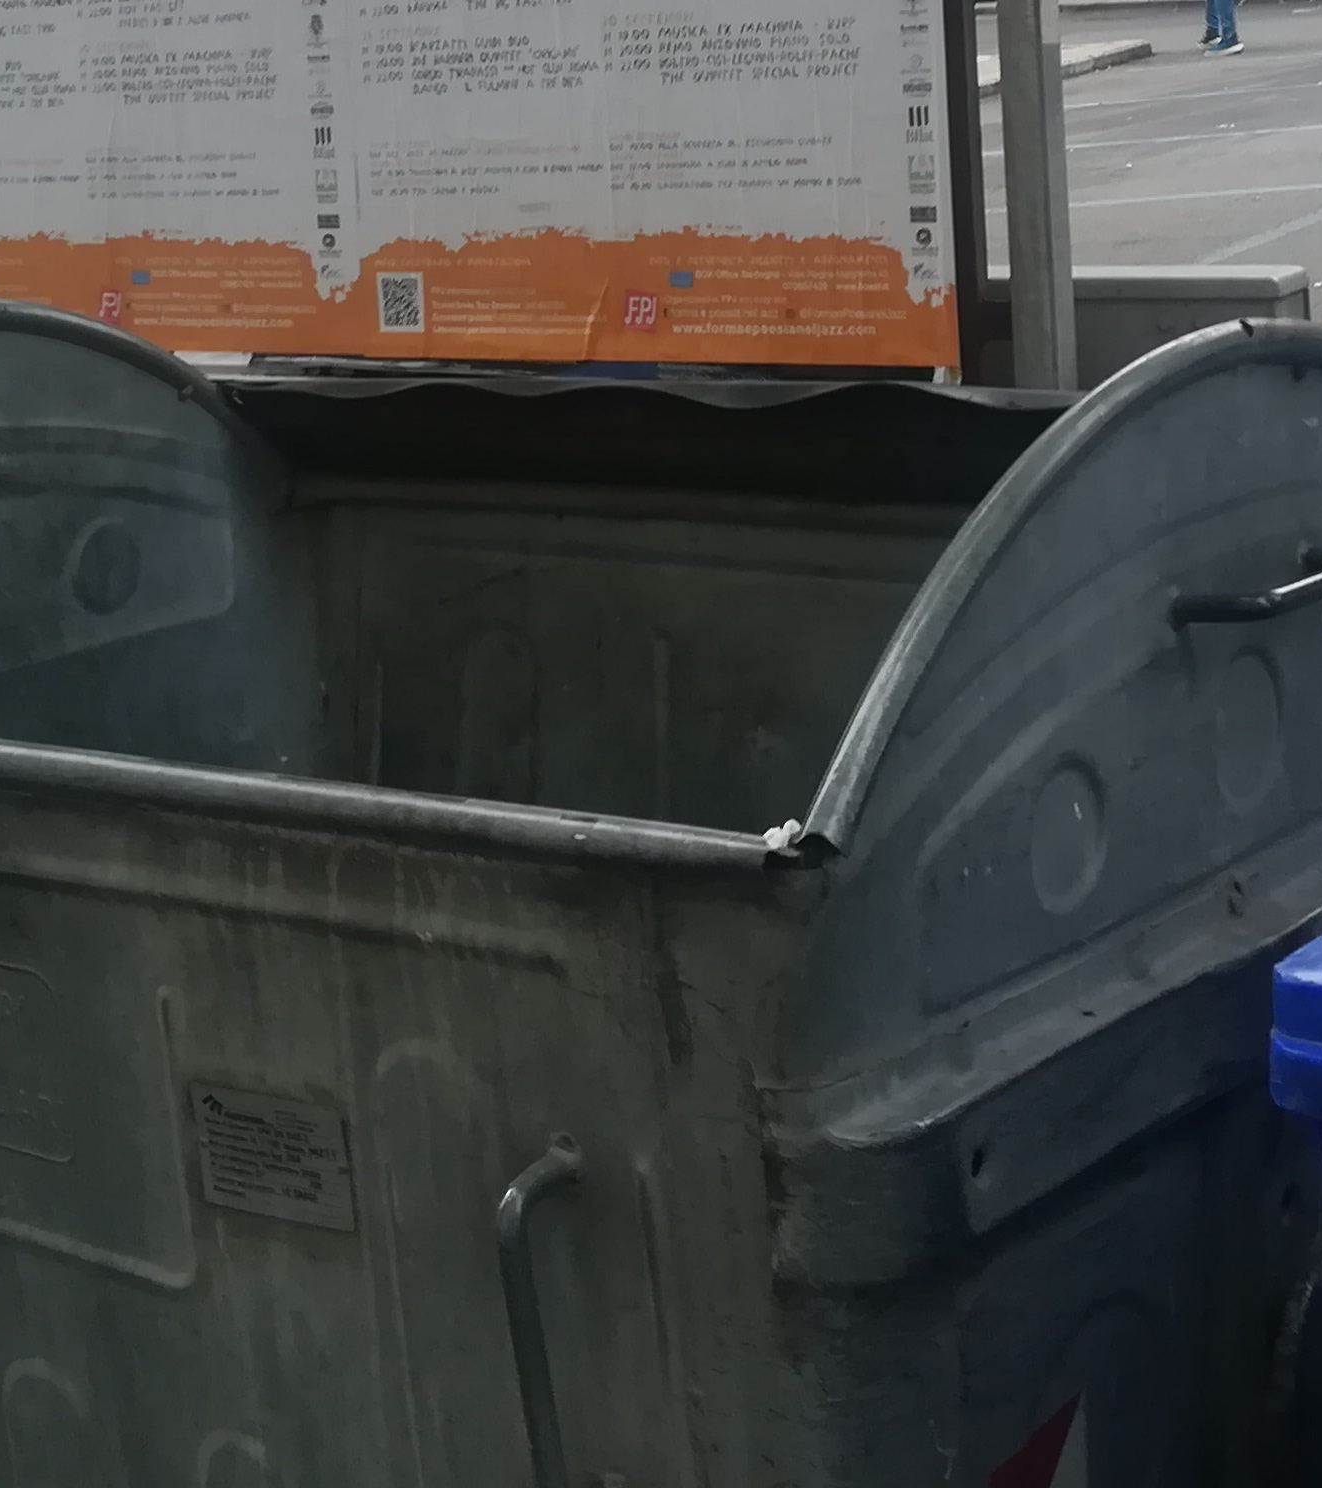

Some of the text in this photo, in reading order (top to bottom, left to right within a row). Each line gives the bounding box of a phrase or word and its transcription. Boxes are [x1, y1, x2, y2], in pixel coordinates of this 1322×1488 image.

[819, 31, 851, 46] SOLO
[623, 296, 658, 325] FPJ
[672, 323, 877, 337] www.formaepoesianeljazz.com
